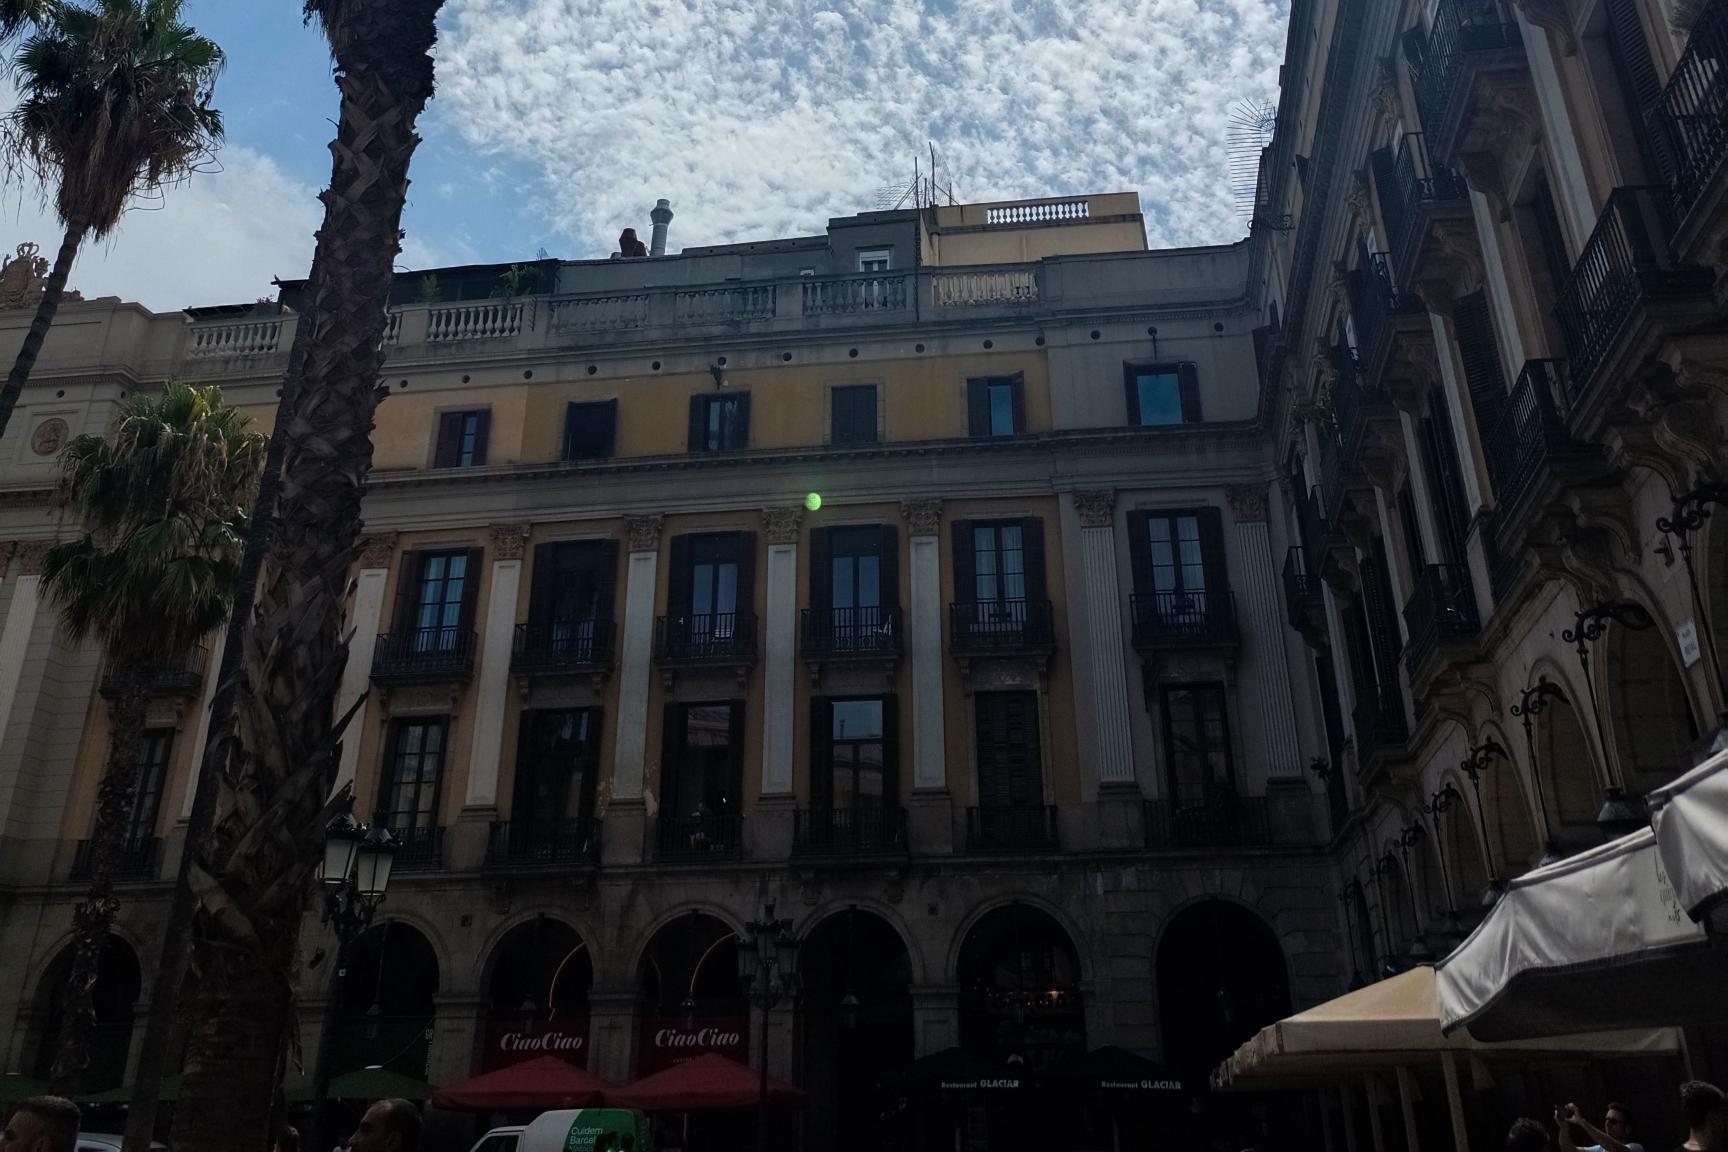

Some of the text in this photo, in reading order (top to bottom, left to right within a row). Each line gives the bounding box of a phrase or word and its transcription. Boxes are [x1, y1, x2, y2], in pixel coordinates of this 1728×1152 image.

[500, 1032, 584, 1051] CiaoCiao
[655, 1028, 740, 1048] CiaoCiao
[941, 1079, 1019, 1089] Restaurant GLACIAR
[1141, 1079, 1182, 1090] GLACIAR
[571, 1126, 603, 1135] Cuidem
[569, 1135, 596, 1145] Barcel
